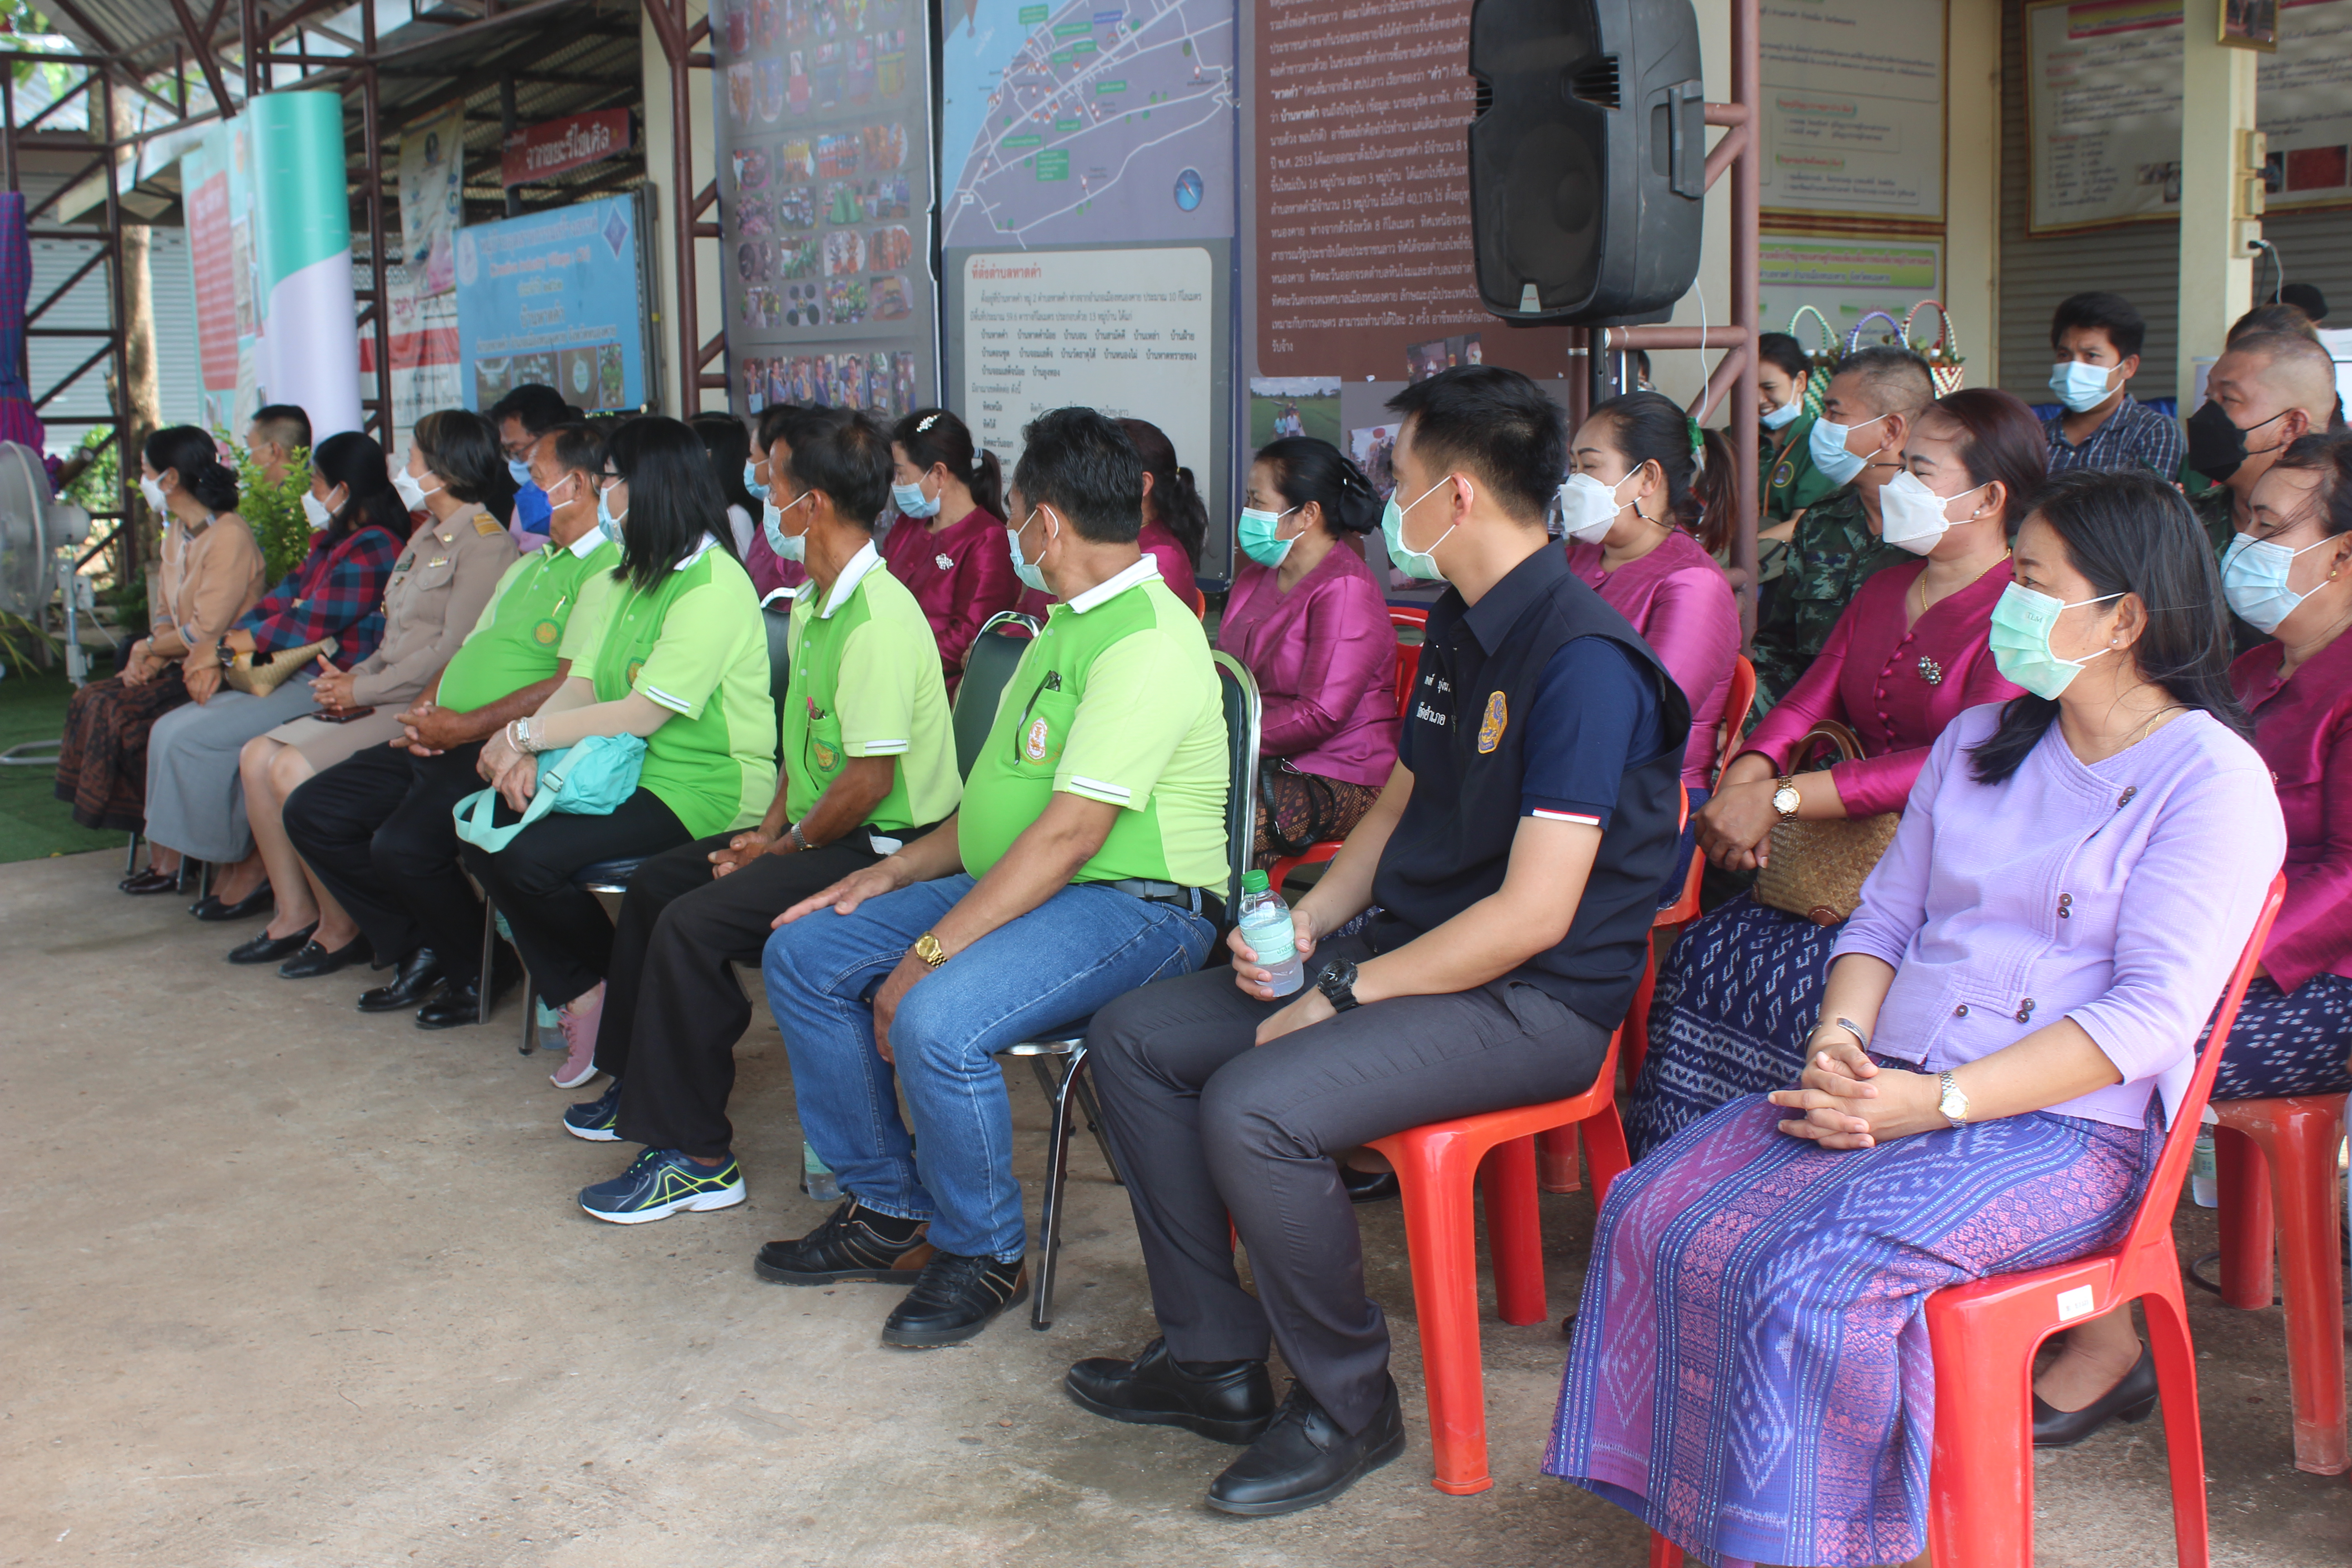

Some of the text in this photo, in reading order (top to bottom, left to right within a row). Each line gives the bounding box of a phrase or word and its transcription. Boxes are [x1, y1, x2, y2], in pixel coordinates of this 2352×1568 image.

[1294, 155, 1313, 167] 2513
[1455, 139, 1461, 152] 8
[1309, 177, 1318, 189] 16
[1320, 172, 1346, 192] หมู่บ้าน
[1368, 173, 1374, 184] 3
[1375, 167, 1401, 187] หมู่บ้าน
[1342, 198, 1351, 210] 13
[1353, 193, 1378, 213] หมู่บ้าน
[1271, 227, 1305, 238] หนองคาย
[1310, 218, 1372, 235] ห่างจากตัวจังหวัด
[1375, 220, 1380, 231] 8
[1383, 216, 1415, 230] กิโลเมตร
[971, 258, 1042, 279] ที่ตั้งตำบลหาดคำ
[1272, 273, 1305, 284] หนองคาย
[1032, 293, 1036, 303] 2
[1038, 291, 1068, 303] ตำบลหาดคำ
[1143, 292, 1167, 302] ประมาณ
[1169, 292, 1176, 301] 10
[1178, 289, 1202, 301] กิโลเมตร
[1089, 312, 1096, 320] 13
[1098, 309, 1117, 324] หมู่บ้าน
[1272, 315, 1336, 330] เหมาะกับการเกษตร
[1409, 314, 1414, 325] 2
[1416, 306, 1430, 324] ครั้ง
[981, 328, 1008, 339] บ้านหาดคำ
[1017, 328, 1056, 340] บ้านหาดคำน้อย
[1064, 328, 1087, 340] บ้านบอน
[1095, 328, 1126, 340] บ้านสามัคคี
[1134, 328, 1160, 340] บ้านเหล่า
[1272, 338, 1293, 353] รับจ้าง
[1019, 346, 1054, 358] บ้านจอมเสด็จ
[1146, 348, 1197, 361] บ้านหาดทรายทอง
[983, 401, 1002, 412] ทิศเหนือ
[983, 418, 996, 429] ทิศใต้
[983, 436, 1014, 448] ทิศตะวันออก
